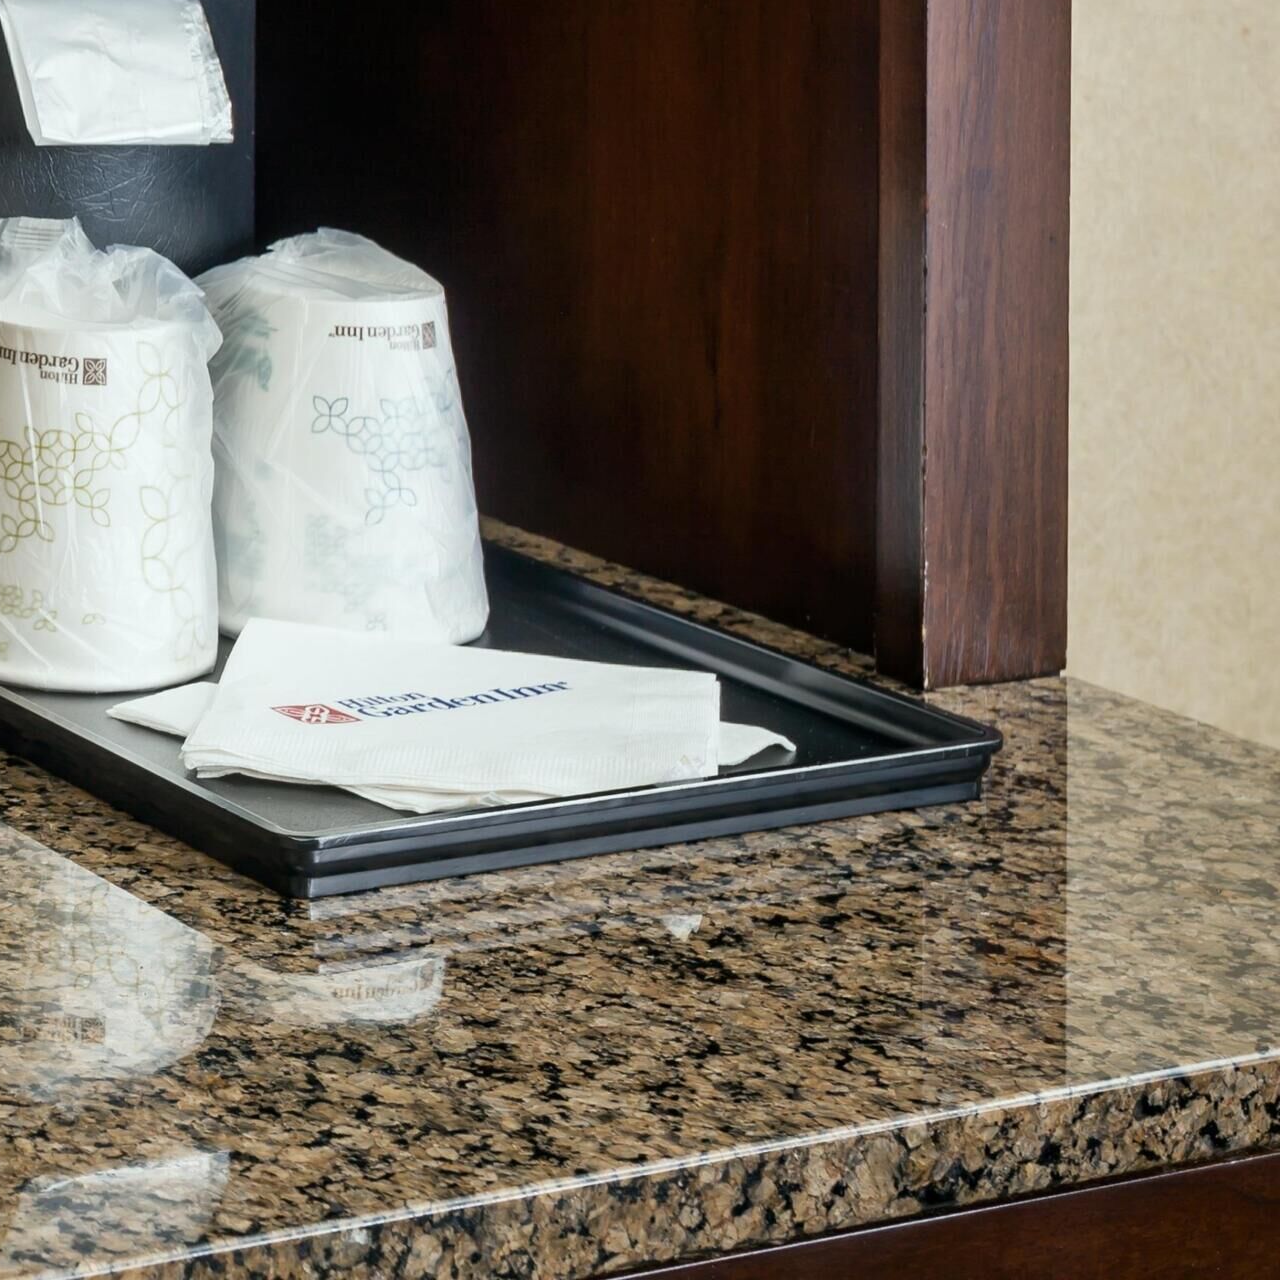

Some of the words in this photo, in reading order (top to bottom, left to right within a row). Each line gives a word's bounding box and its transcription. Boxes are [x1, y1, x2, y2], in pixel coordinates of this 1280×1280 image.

[334, 324, 364, 341] Inn
[20, 350, 80, 373] Garden
[337, 690, 429, 709] Hilton
[356, 690, 493, 718] Garden
[490, 680, 563, 703] Inn
